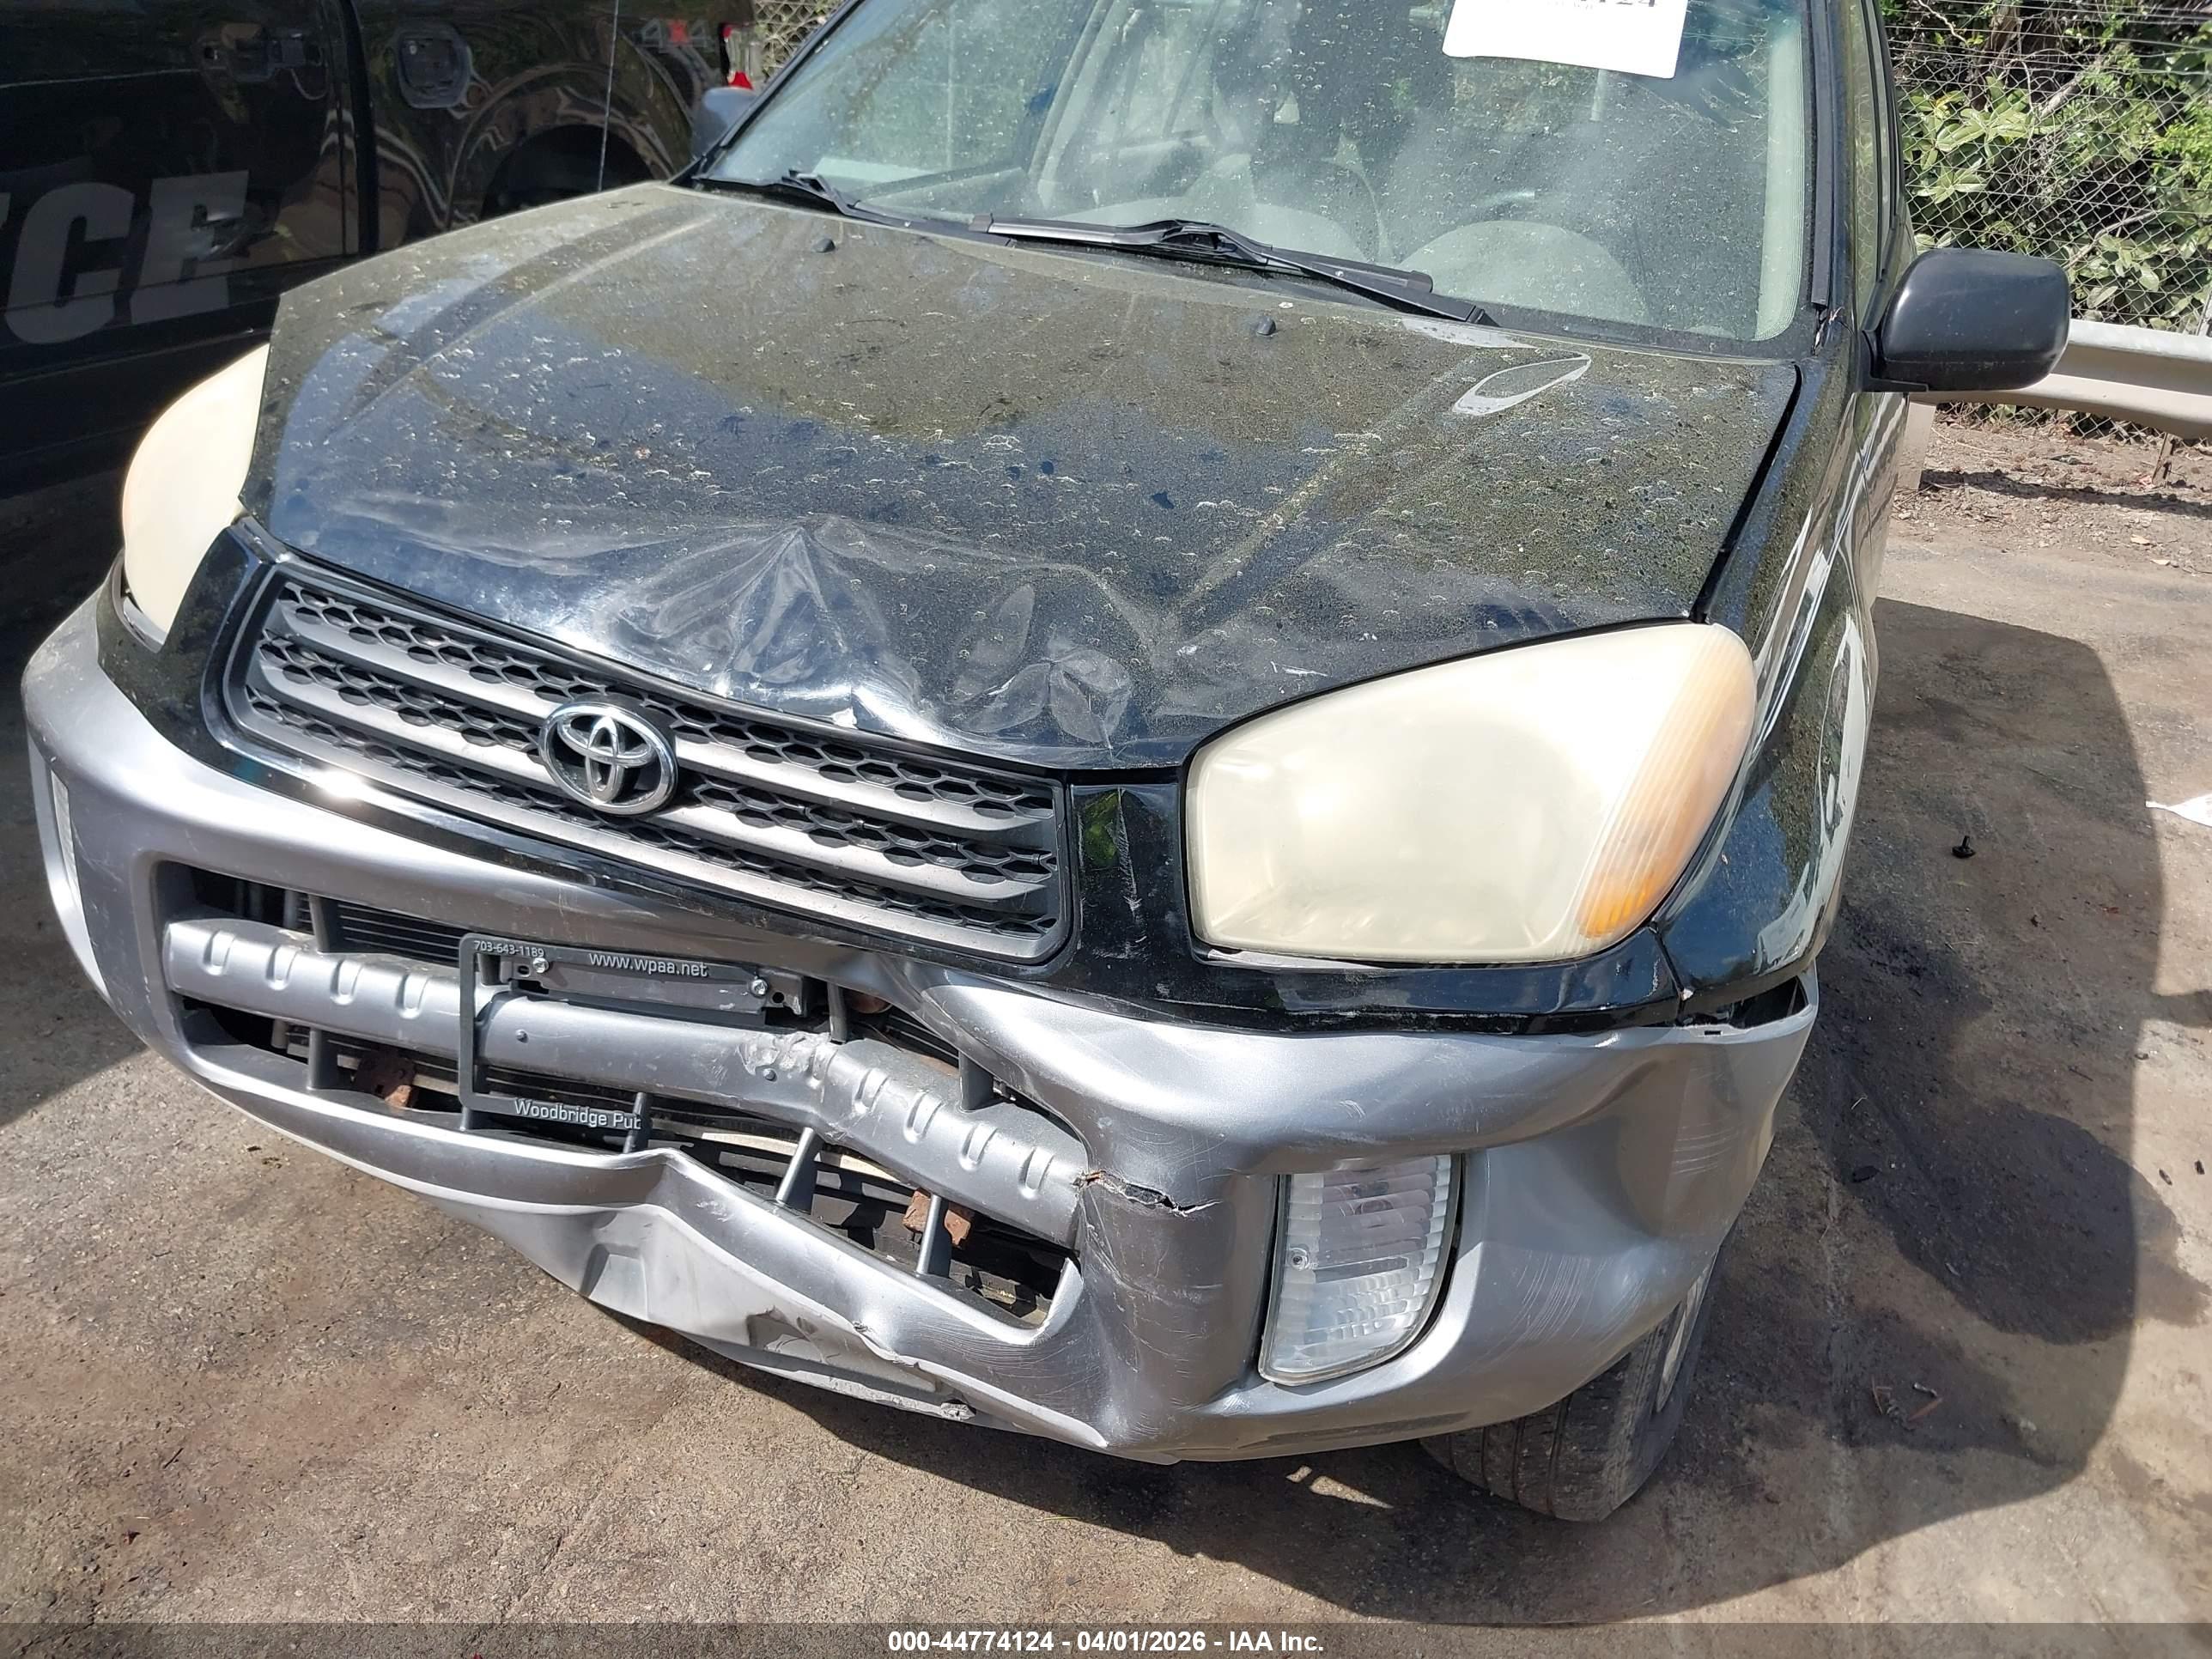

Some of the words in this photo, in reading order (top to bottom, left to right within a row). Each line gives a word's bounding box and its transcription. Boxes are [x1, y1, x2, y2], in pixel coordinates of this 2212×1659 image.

[0, 171, 249, 343] CE
[474, 940, 544, 957] 703-643-1189
[589, 953, 708, 977] www.wpaa.net
[515, 1098, 607, 1127] Woodbridge
